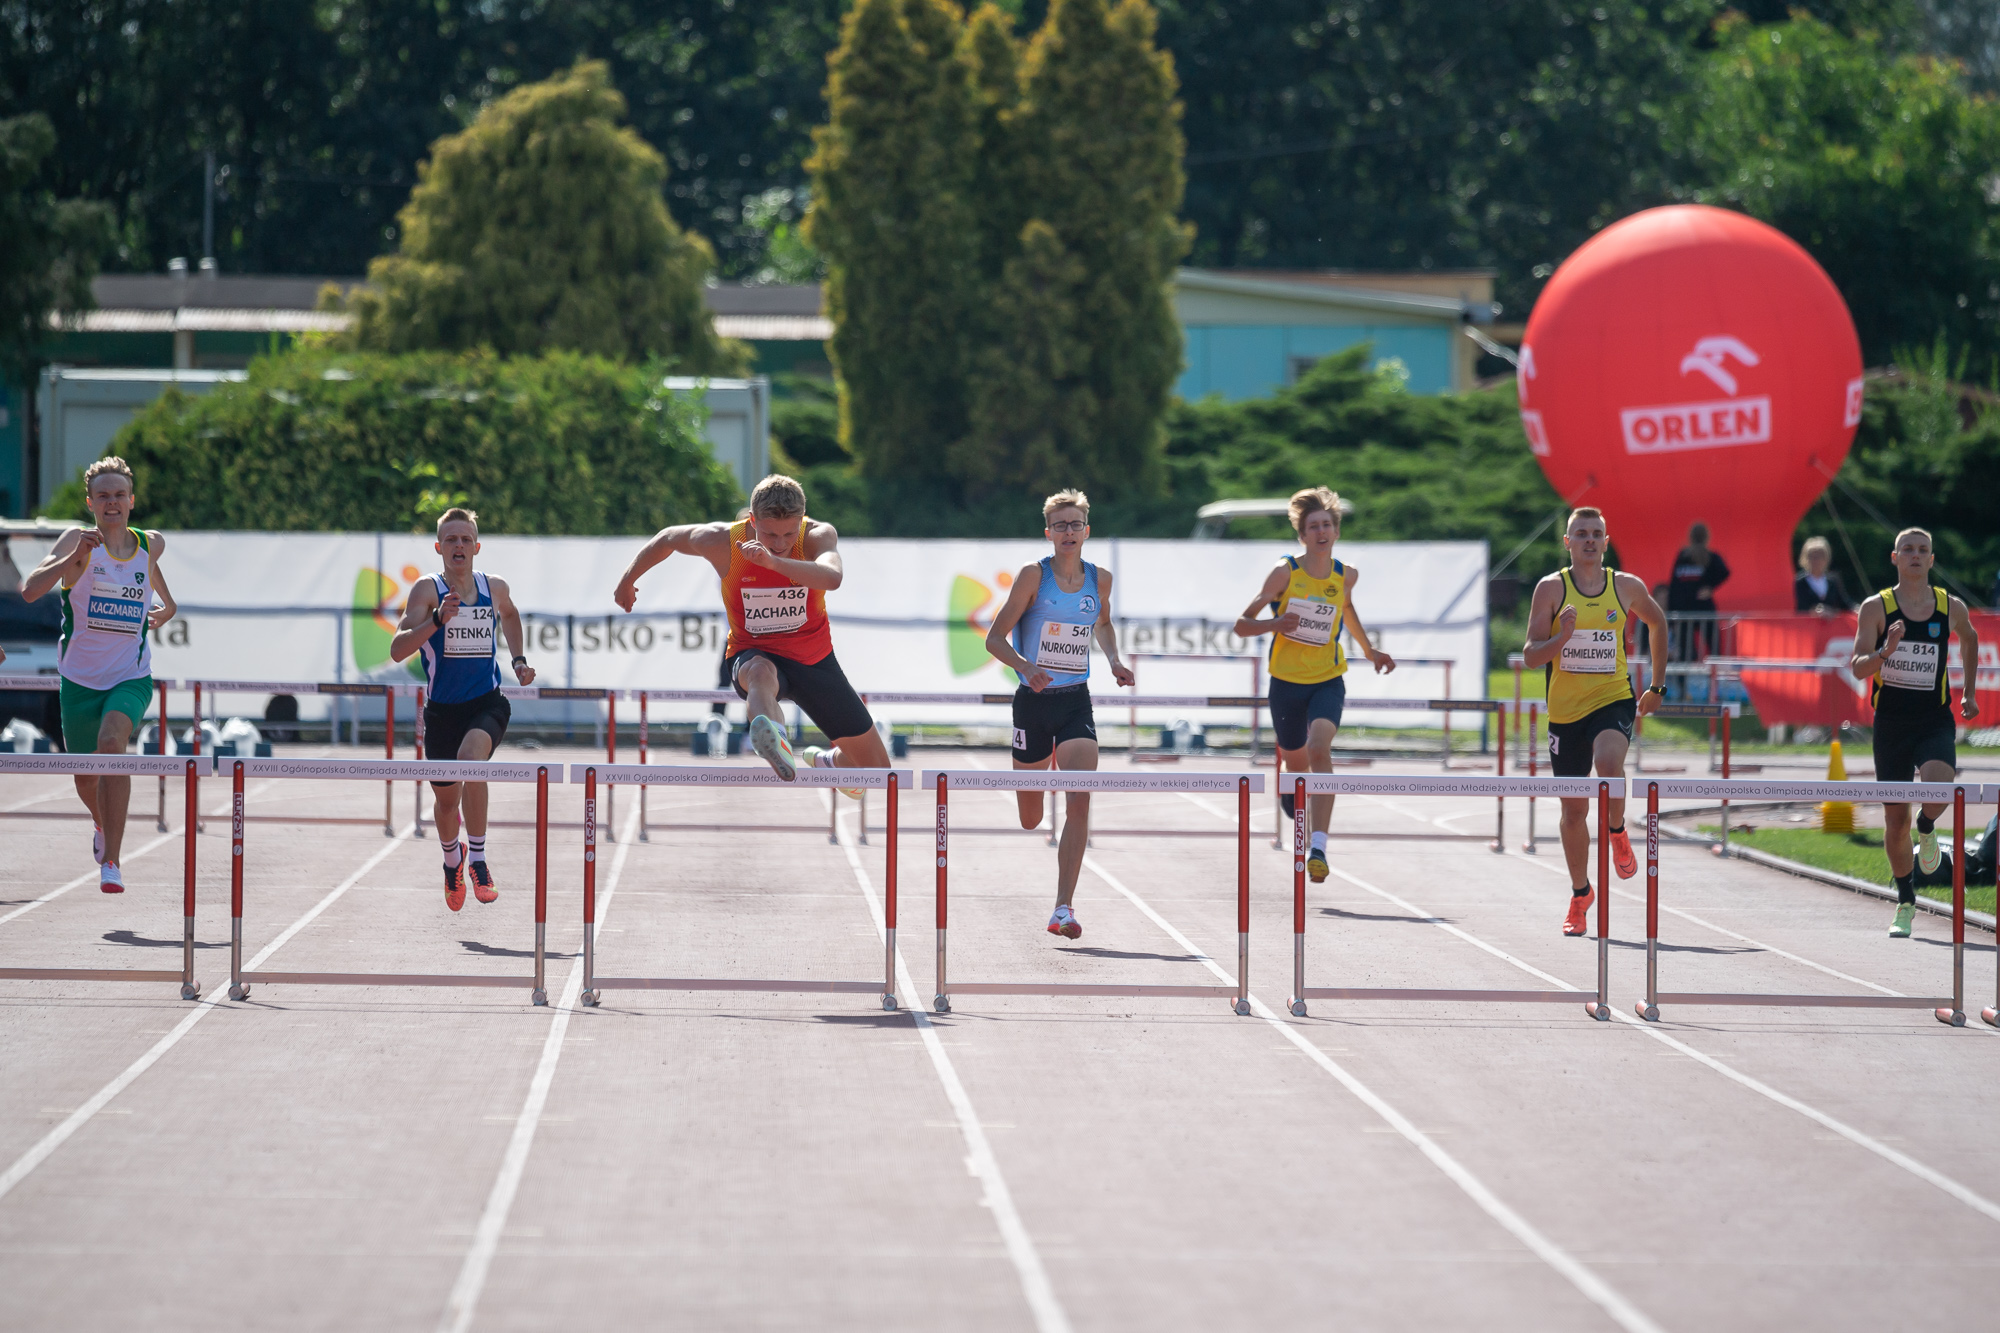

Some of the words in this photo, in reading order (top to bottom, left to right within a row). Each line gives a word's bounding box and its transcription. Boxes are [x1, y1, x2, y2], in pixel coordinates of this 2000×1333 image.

[1633, 407, 1760, 445] ORLEN
[121, 586, 143, 600] 209
[777, 588, 806, 600] 436
[90, 601, 142, 618] KACZMAREK
[472, 608, 493, 620] 124
[745, 605, 806, 620] ZACHARA
[1314, 604, 1335, 616] 257
[447, 627, 492, 639] STENKA
[1072, 626, 1090, 638] 547
[1592, 631, 1614, 642] 165
[1562, 647, 1616, 659] CHMIELEWSKI
[1912, 644, 1935, 656] 814
[1884, 658, 1936, 673] WASIELEWSKI
[1014, 730, 1023, 748] 4
[48, 760, 95, 770] Młodzieży
[108, 761, 137, 771] lekkiej
[140, 762, 179, 771] atletyce
[252, 764, 278, 772] XXVIII
[281, 764, 346, 774] Ogólnopolska
[349, 766, 397, 775] Olimpiada
[401, 767, 446, 777] Młodzieży
[460, 768, 489, 778] lekkiej
[491, 769, 530, 778] atletyce
[605, 773, 631, 781] XXVIII
[634, 773, 698, 783] Ogólnopolska
[701, 774, 750, 783] Olimpiada
[753, 775, 798, 784] Młodzy
[811, 775, 840, 784] lekkiej
[843, 775, 881, 785] atletyce
[955, 778, 980, 786] XXVIII
[983, 777, 1047, 787] Ogólnopolska
[1050, 779, 1099, 788] Olimpiada
[1101, 779, 1147, 788] Młodzieży
[1160, 780, 1189, 789] lekkiej
[1192, 780, 1231, 789] atletyce
[1313, 782, 1339, 790] XXVIII
[1341, 782, 1406, 792] Ogólnopolska
[1409, 784, 1458, 793] Olimpiada
[1461, 784, 1508, 793] Młodzieży
[1520, 784, 1549, 793] lekkiej
[1552, 785, 1591, 794] atletyce
[1667, 785, 1693, 793] XXVIII
[1695, 785, 1761, 795] Ogólnopolska
[1764, 787, 1813, 796] Olimpiada
[1816, 788, 1863, 797] Młodzieży
[1876, 788, 1905, 798] lekkiej
[1908, 789, 1948, 798] atletyce
[234, 793, 242, 836] POLANIK
[586, 800, 594, 842] POLANIK
[938, 806, 946, 848] POLANIK
[1296, 810, 1304, 852] POLANIK
[1649, 815, 1657, 857] POLANIK
